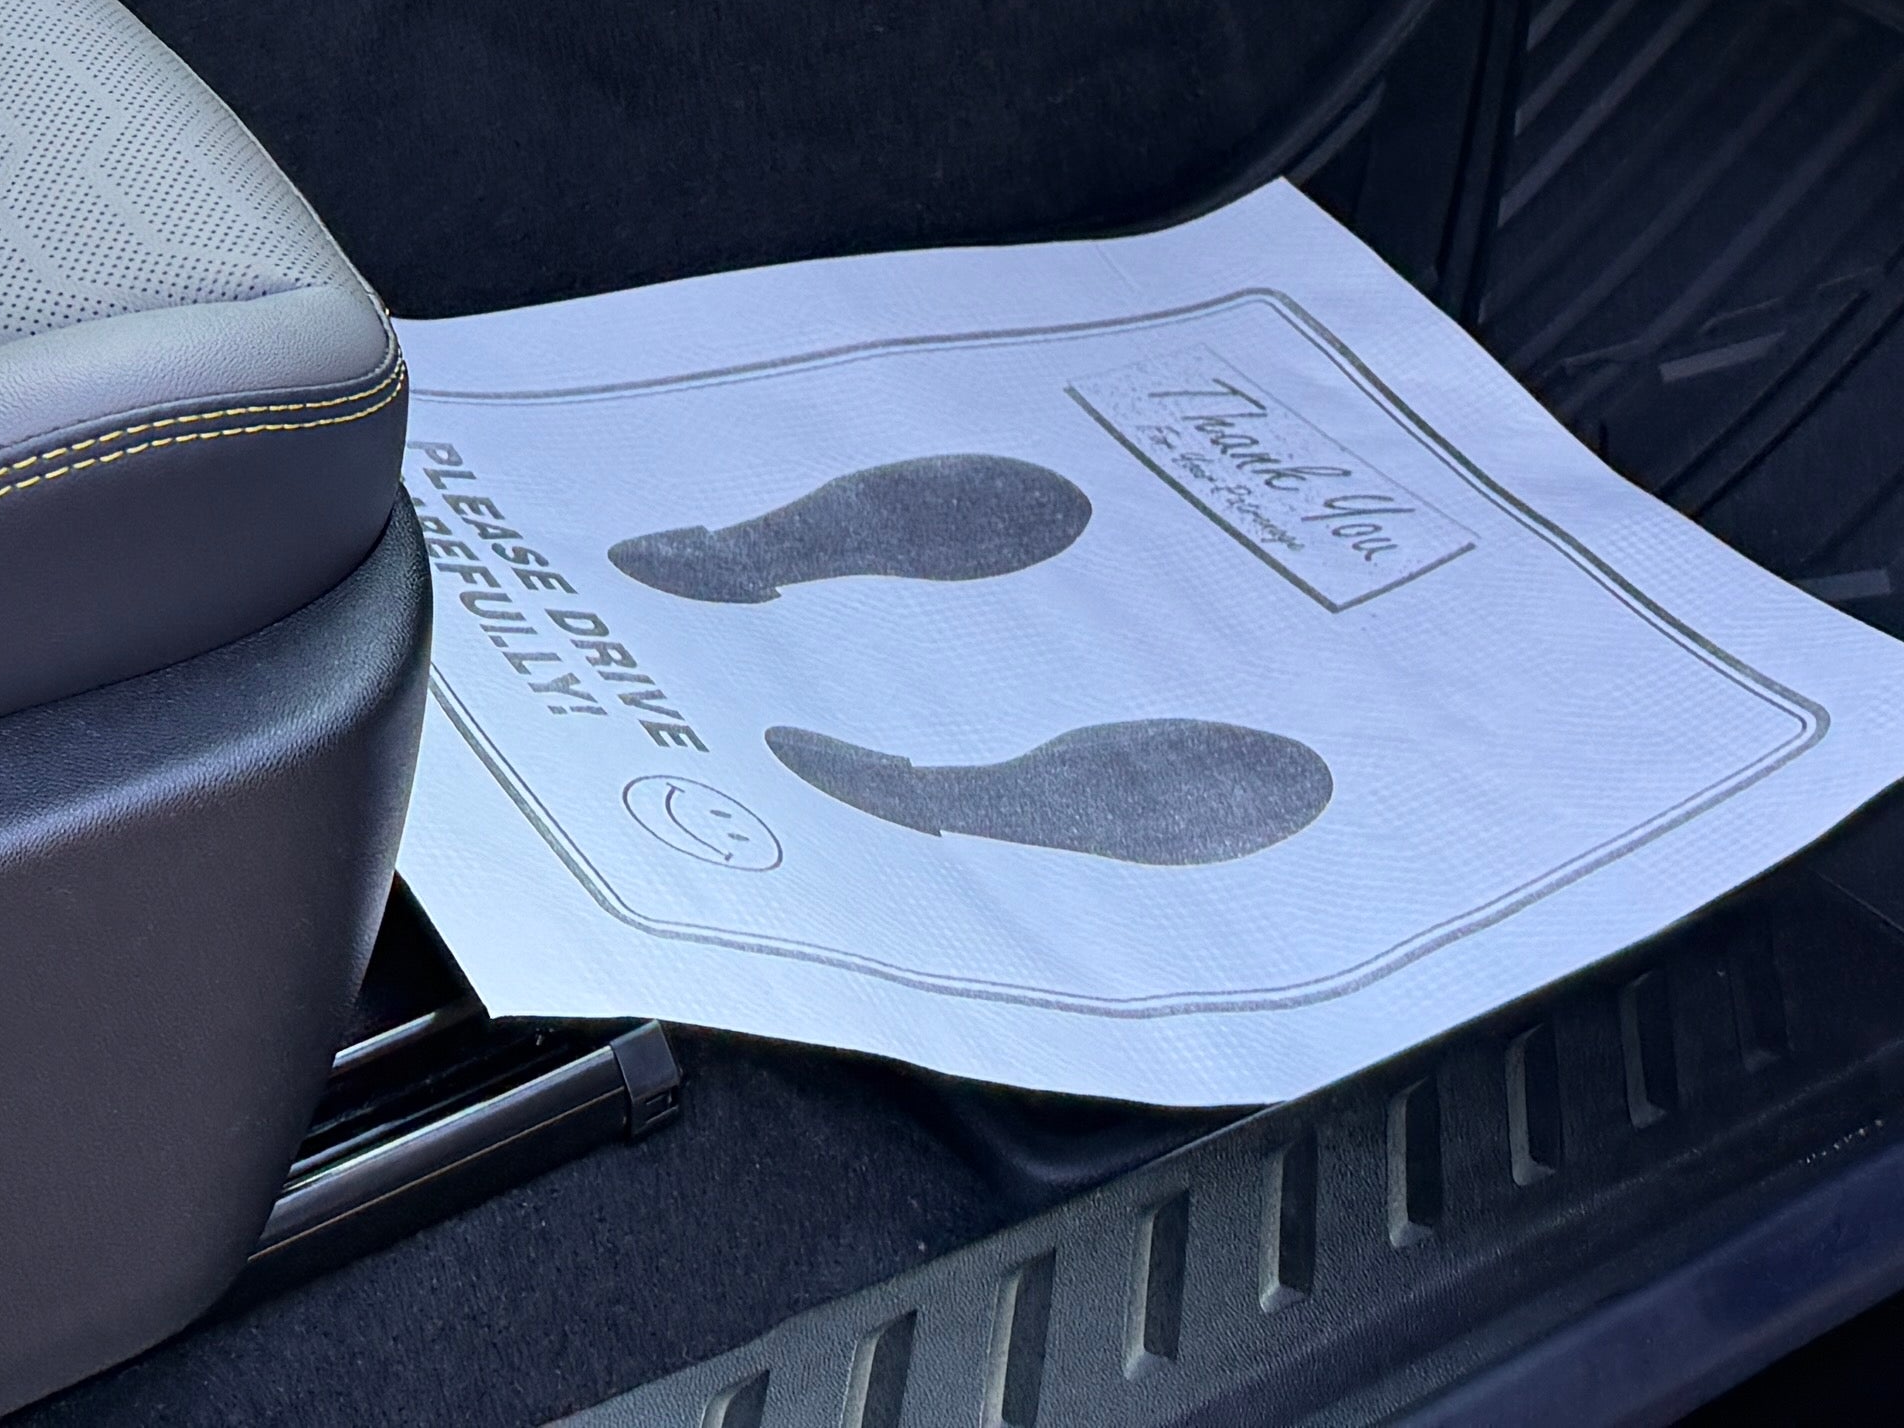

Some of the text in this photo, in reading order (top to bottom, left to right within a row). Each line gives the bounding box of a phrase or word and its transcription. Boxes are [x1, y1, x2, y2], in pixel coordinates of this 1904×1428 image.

[1148, 376, 1417, 563] Thank You
[406, 440, 711, 753] PLEASE DRIVE
[406, 484, 609, 718] REFULLY!
